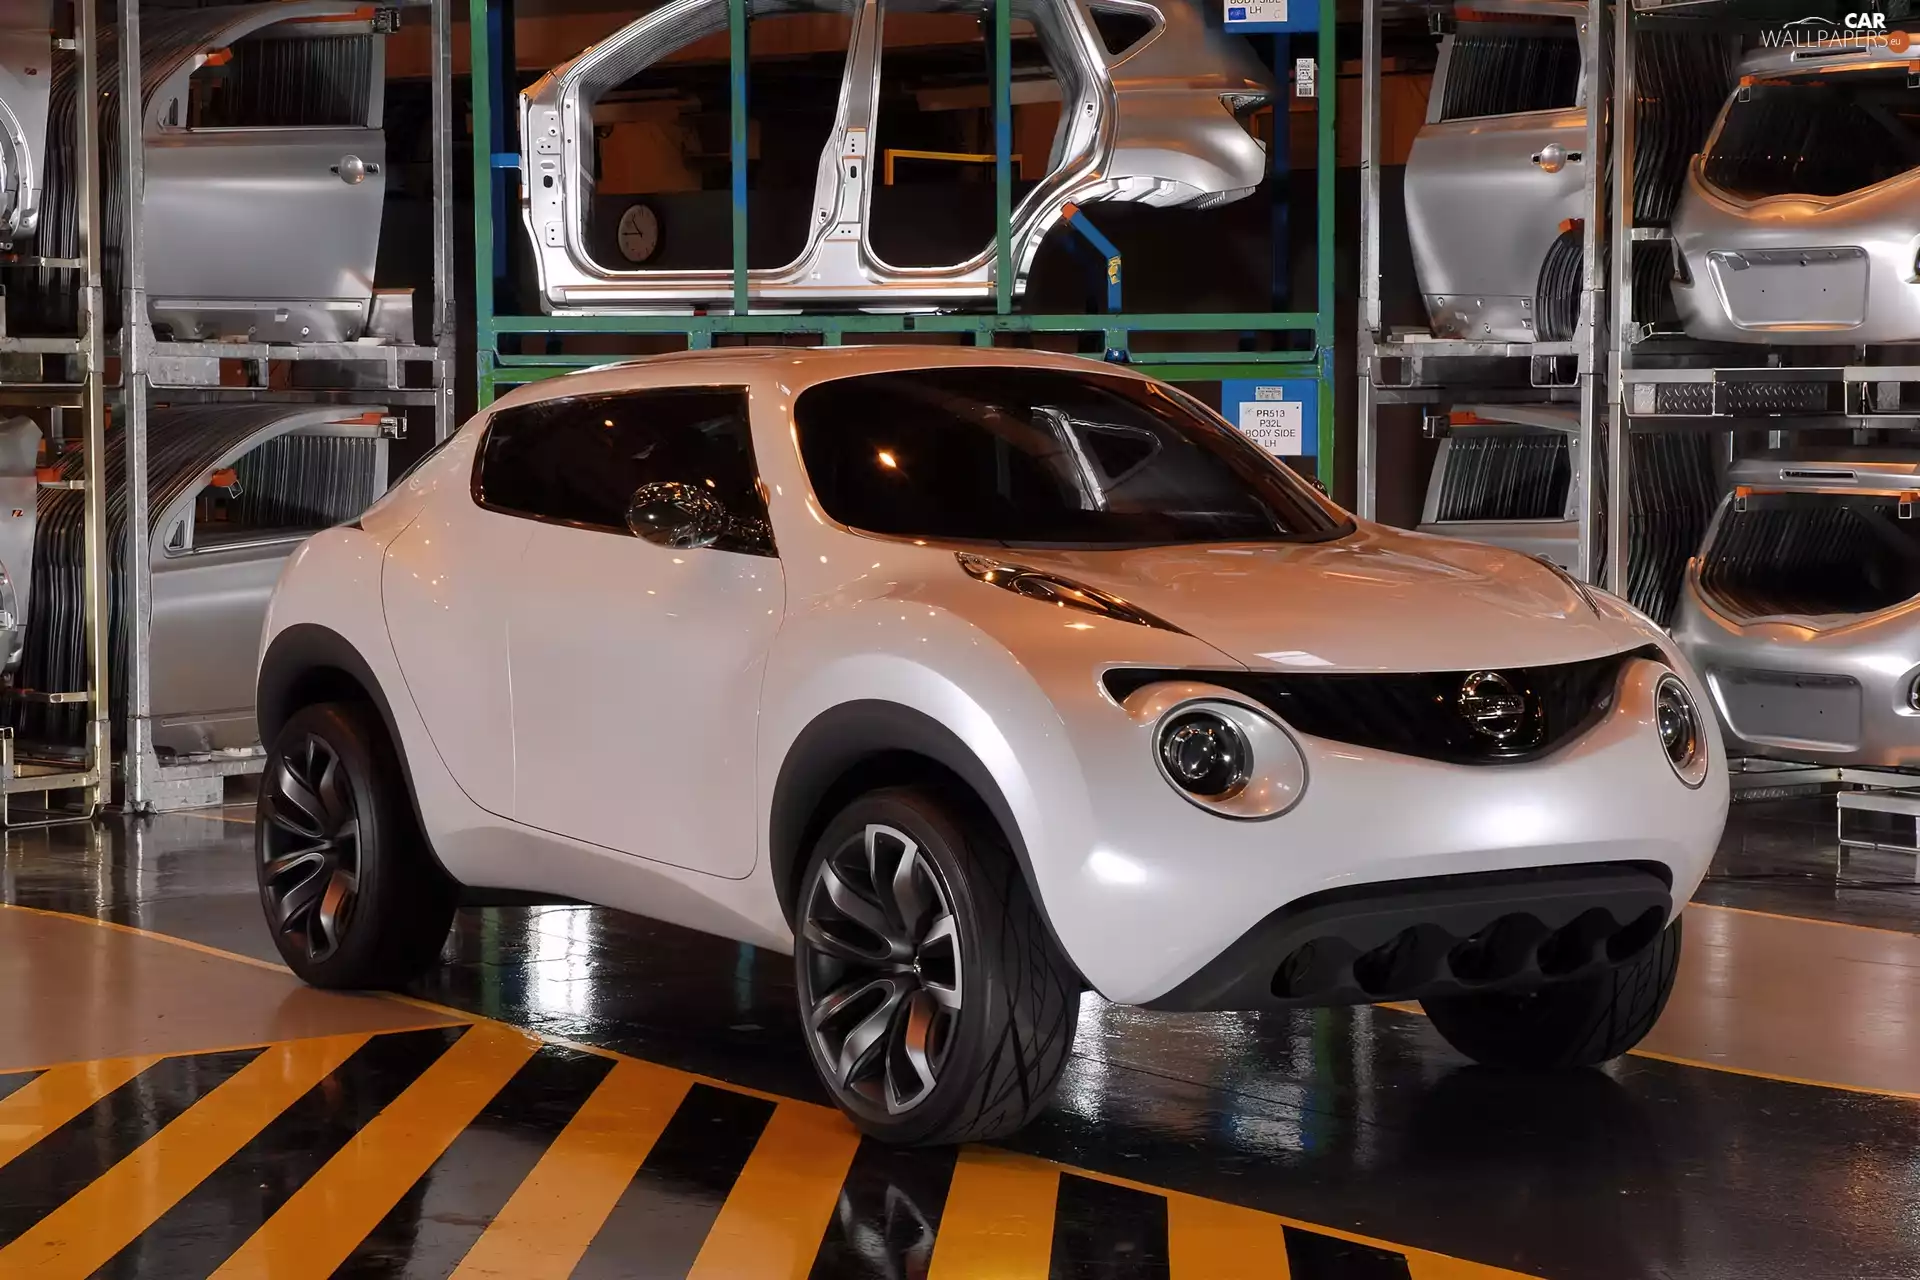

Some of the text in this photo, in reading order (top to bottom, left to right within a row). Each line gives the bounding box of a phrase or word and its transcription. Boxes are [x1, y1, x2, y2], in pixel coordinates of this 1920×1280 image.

[1256, 409, 1285, 417] PR513
[1259, 419, 1281, 427] P32L
[1245, 429, 1295, 437] BODY SIDE
